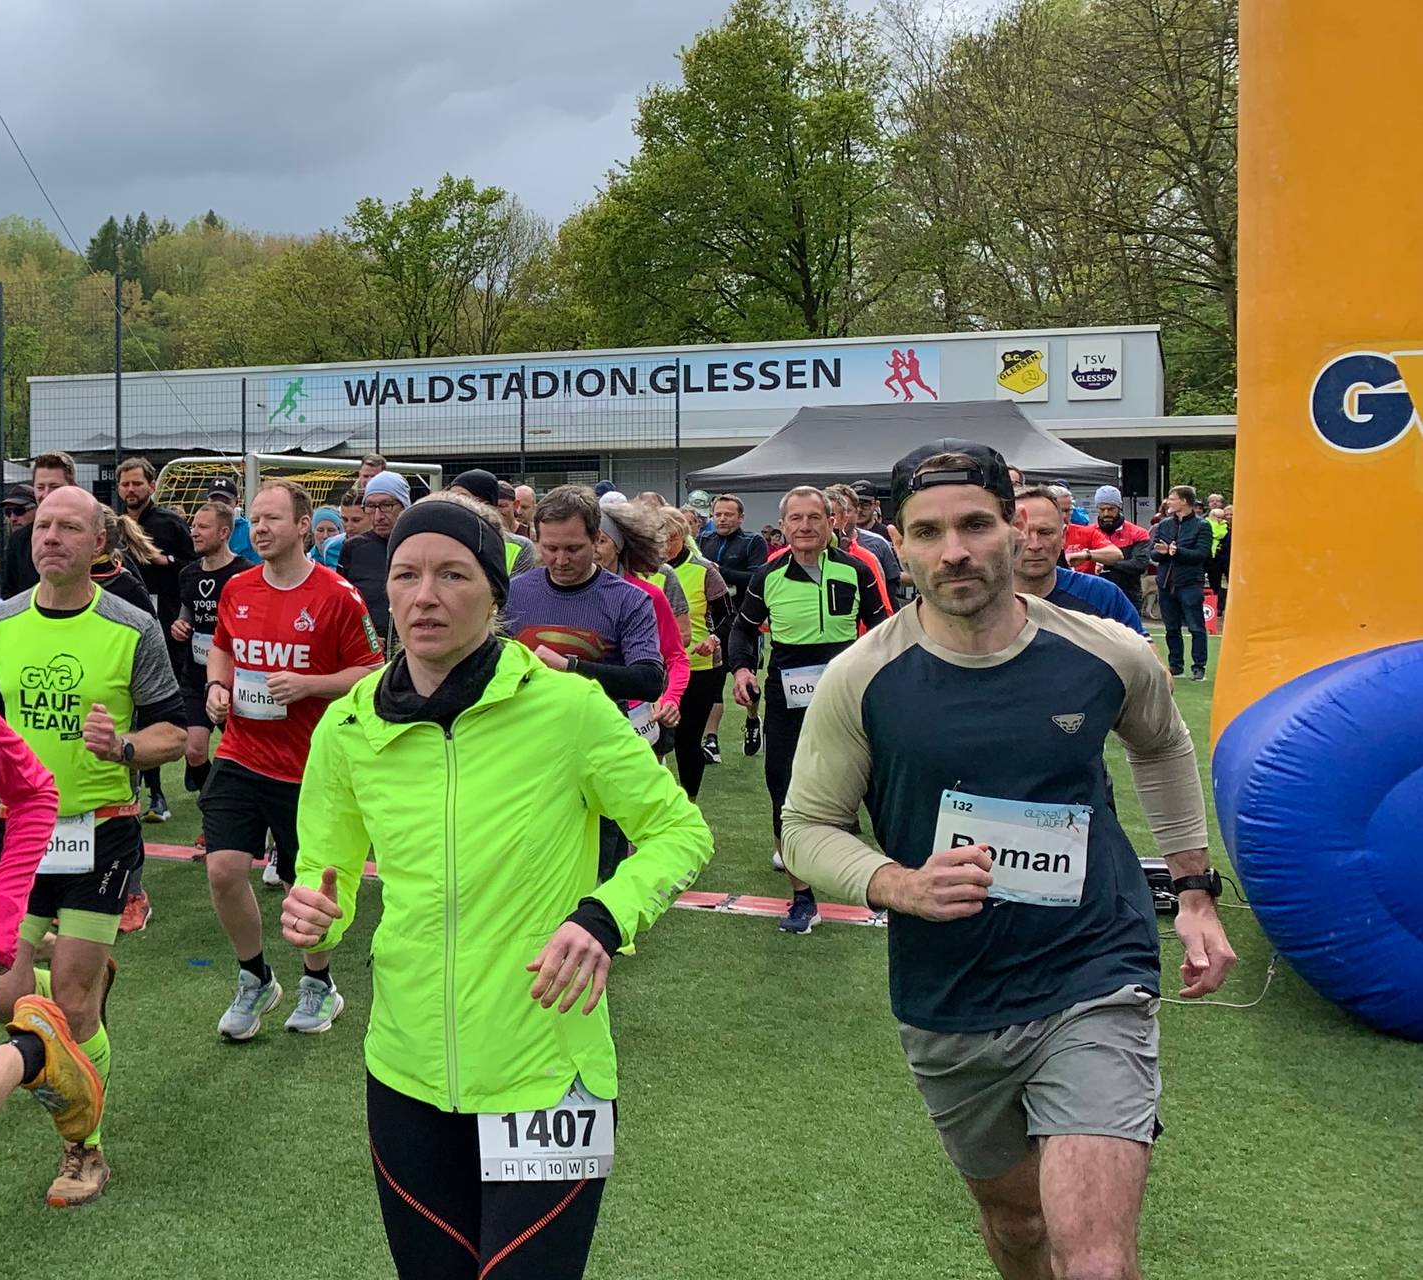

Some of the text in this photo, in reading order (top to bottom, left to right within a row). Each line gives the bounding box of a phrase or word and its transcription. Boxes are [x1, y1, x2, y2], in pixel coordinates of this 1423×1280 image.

[999, 353, 1039, 380] GLESSEN
[1083, 354, 1107, 365] TSV
[344, 357, 841, 407] WALDSTADION GLESSEN
[1075, 373, 1114, 383] GLESSEN
[1308, 349, 1423, 454] G
[193, 600, 217, 611] yoga
[194, 613, 203, 624] by
[363, 616, 379, 649] DEVK
[232, 638, 310, 669] REWE
[20, 665, 75, 692] GVG
[790, 683, 814, 695] Rob
[20, 689, 81, 713] LAUF
[20, 710, 80, 731] TEAM
[952, 800, 973, 813] 132
[501, 1109, 597, 1148] 1407
[505, 1163, 595, 1175] H K 10 W 5
